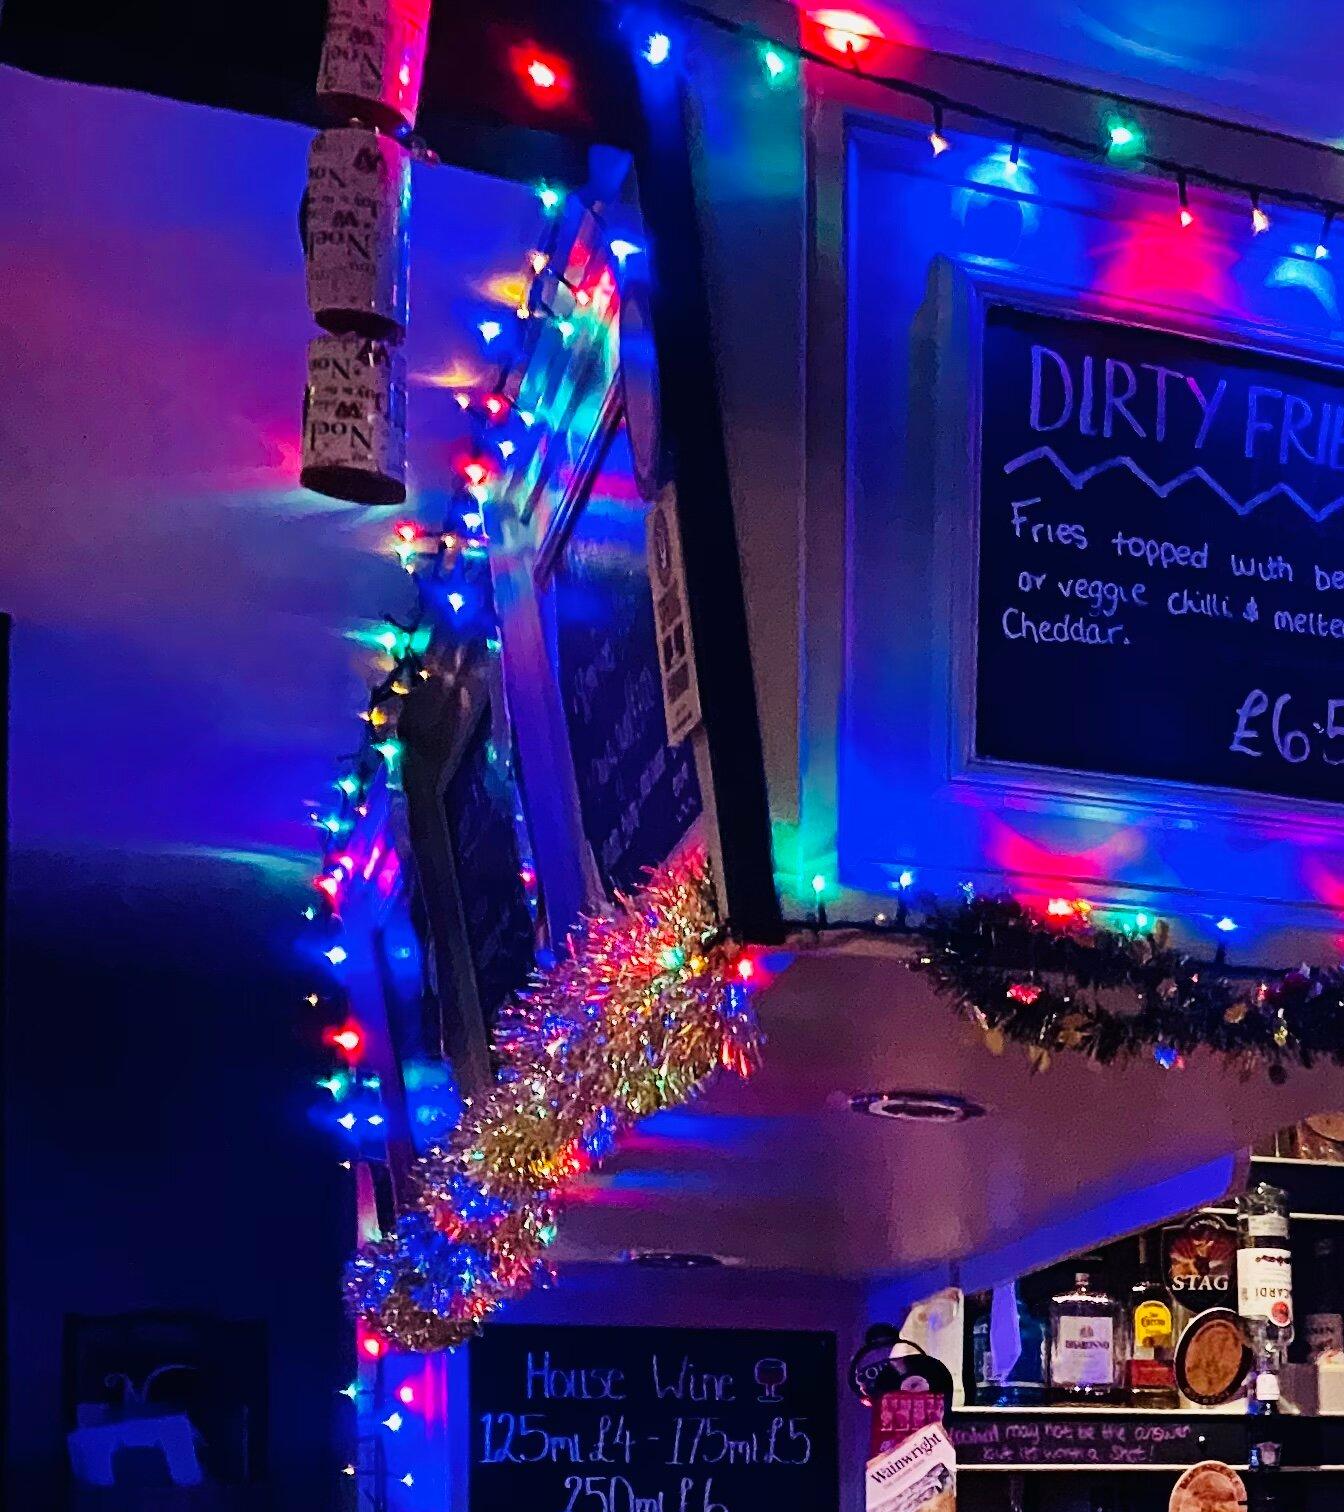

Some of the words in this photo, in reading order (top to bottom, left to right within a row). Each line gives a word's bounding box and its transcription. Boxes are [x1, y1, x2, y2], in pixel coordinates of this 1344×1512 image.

[1029, 344, 1228, 449] DIRTY
[1010, 497, 1088, 549] Fries
[1111, 531, 1208, 568] topped
[1231, 554, 1294, 582] with
[1018, 571, 1046, 592] or
[1057, 579, 1148, 617] veggie
[1002, 607, 1131, 644] Cheddar.
[1170, 1274, 1230, 1292] STAG
[526, 1351, 628, 1400] House
[651, 1352, 737, 1401] Wine
[477, 1412, 584, 1464] 125ml
[590, 1414, 636, 1464] £4
[765, 1415, 812, 1465] £5
[870, 1431, 942, 1485] Wainwright
